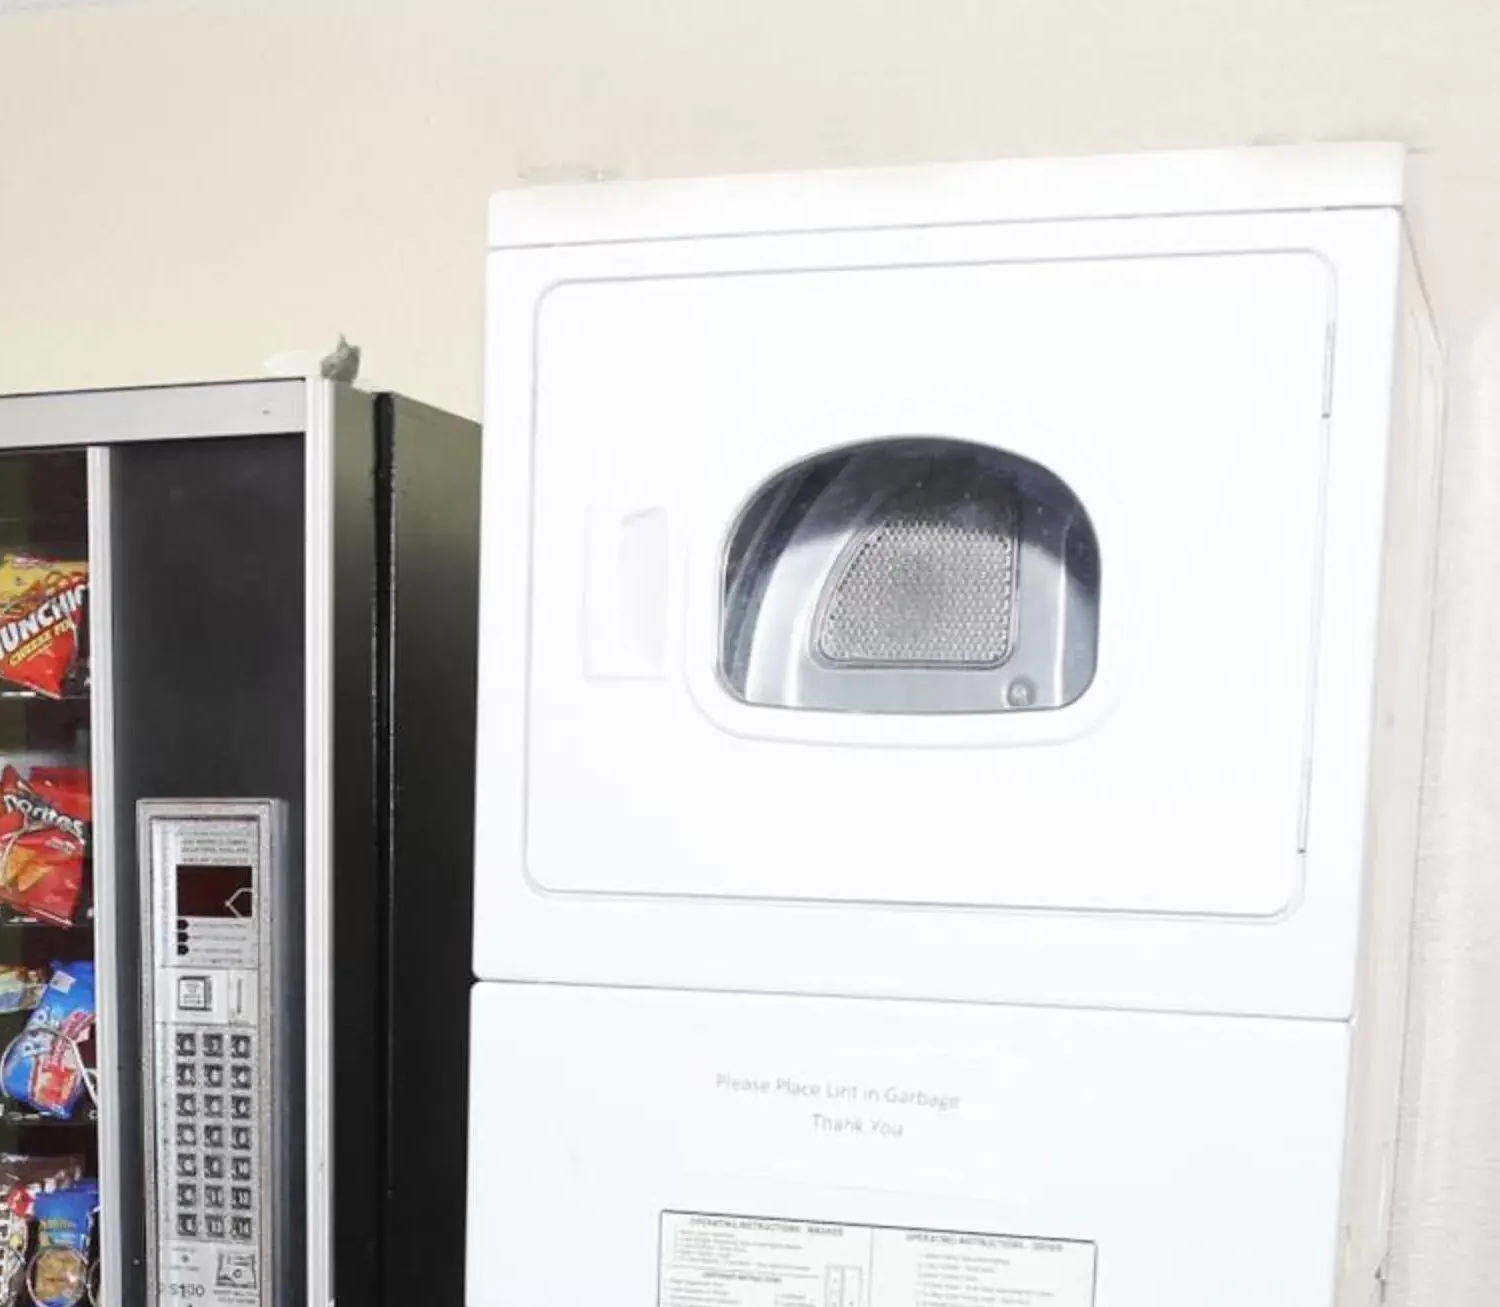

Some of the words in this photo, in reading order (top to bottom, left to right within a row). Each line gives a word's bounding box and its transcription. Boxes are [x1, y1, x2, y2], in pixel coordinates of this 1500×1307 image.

[3, 793, 86, 837] Doritos
[715, 1071, 770, 1095] Please
[775, 1076, 821, 1100] Place
[825, 1081, 857, 1101] Lint
[863, 1084, 879, 1104] in
[884, 1086, 960, 1113] Garbage
[812, 1112, 864, 1135] Thank
[870, 1116, 904, 1139] You
